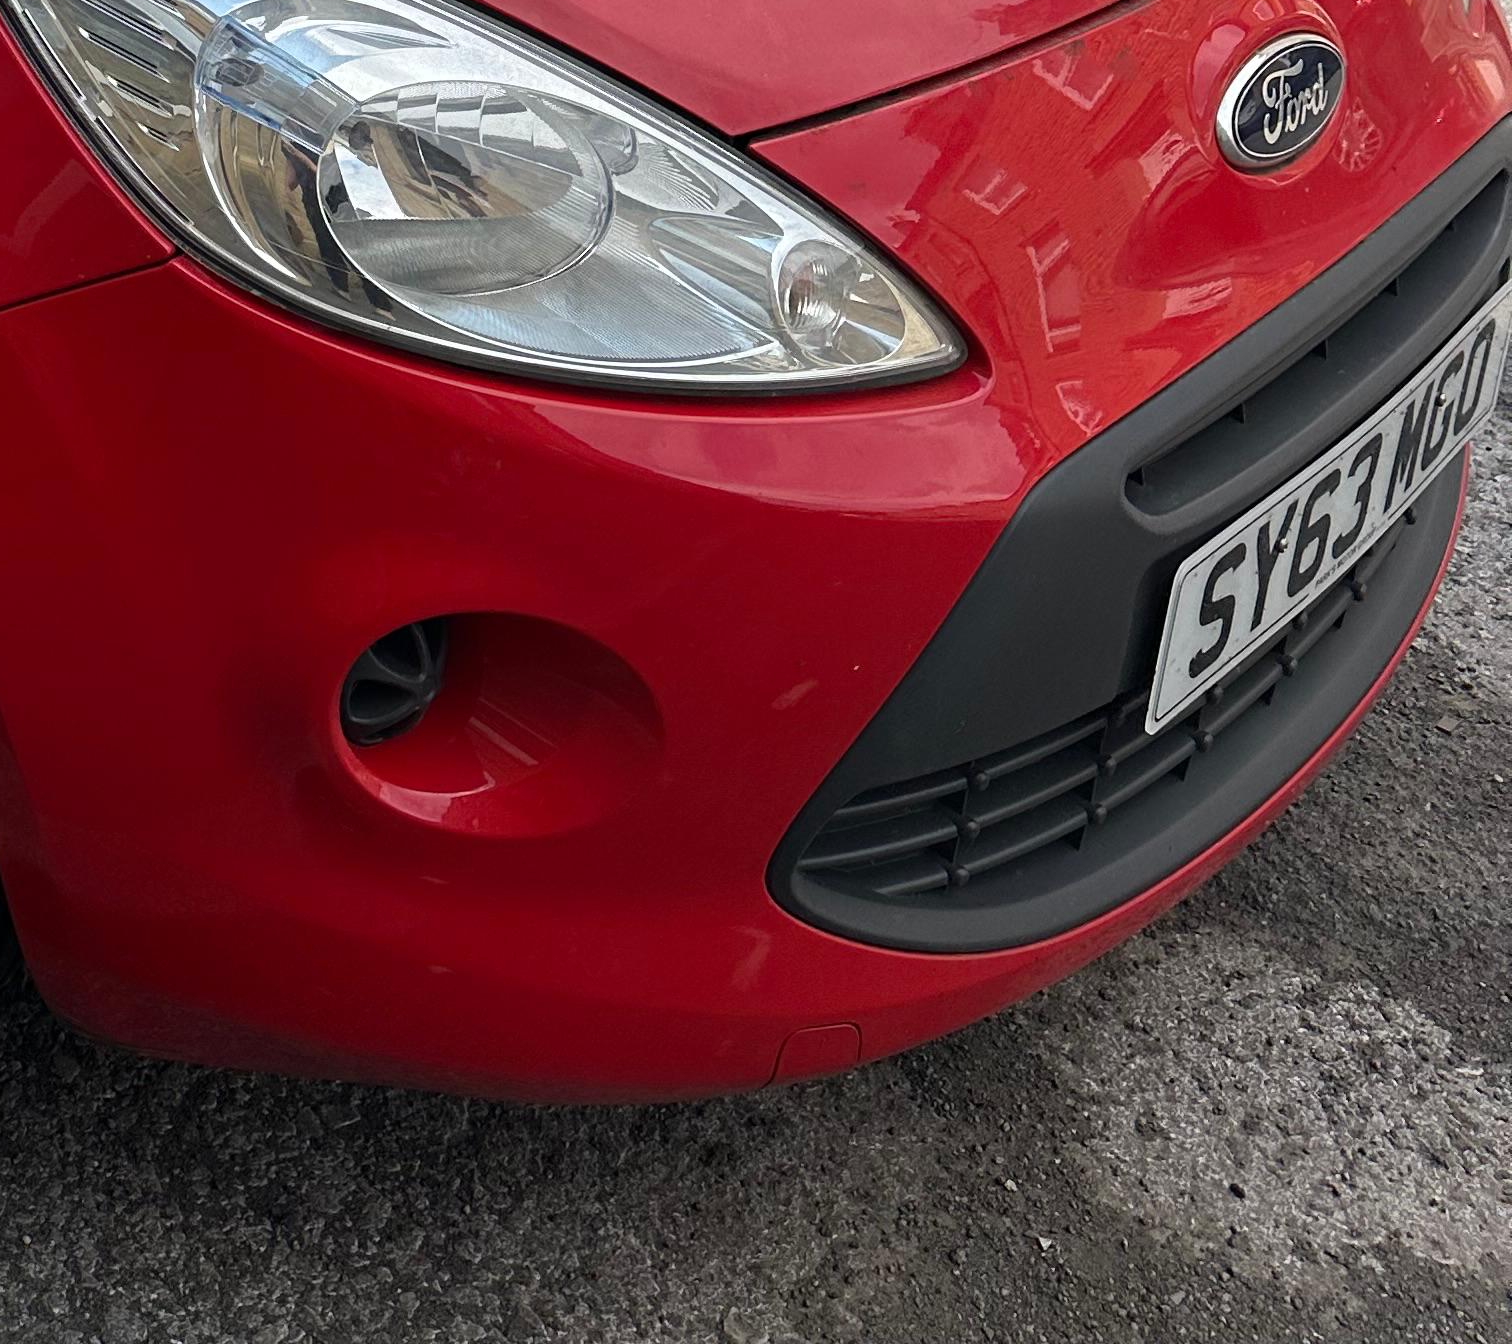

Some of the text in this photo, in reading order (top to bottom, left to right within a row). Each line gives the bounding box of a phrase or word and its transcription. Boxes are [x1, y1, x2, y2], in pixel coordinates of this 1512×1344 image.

[1262, 58, 1329, 144] Ford
[1188, 317, 1496, 679] SY63 MGO
